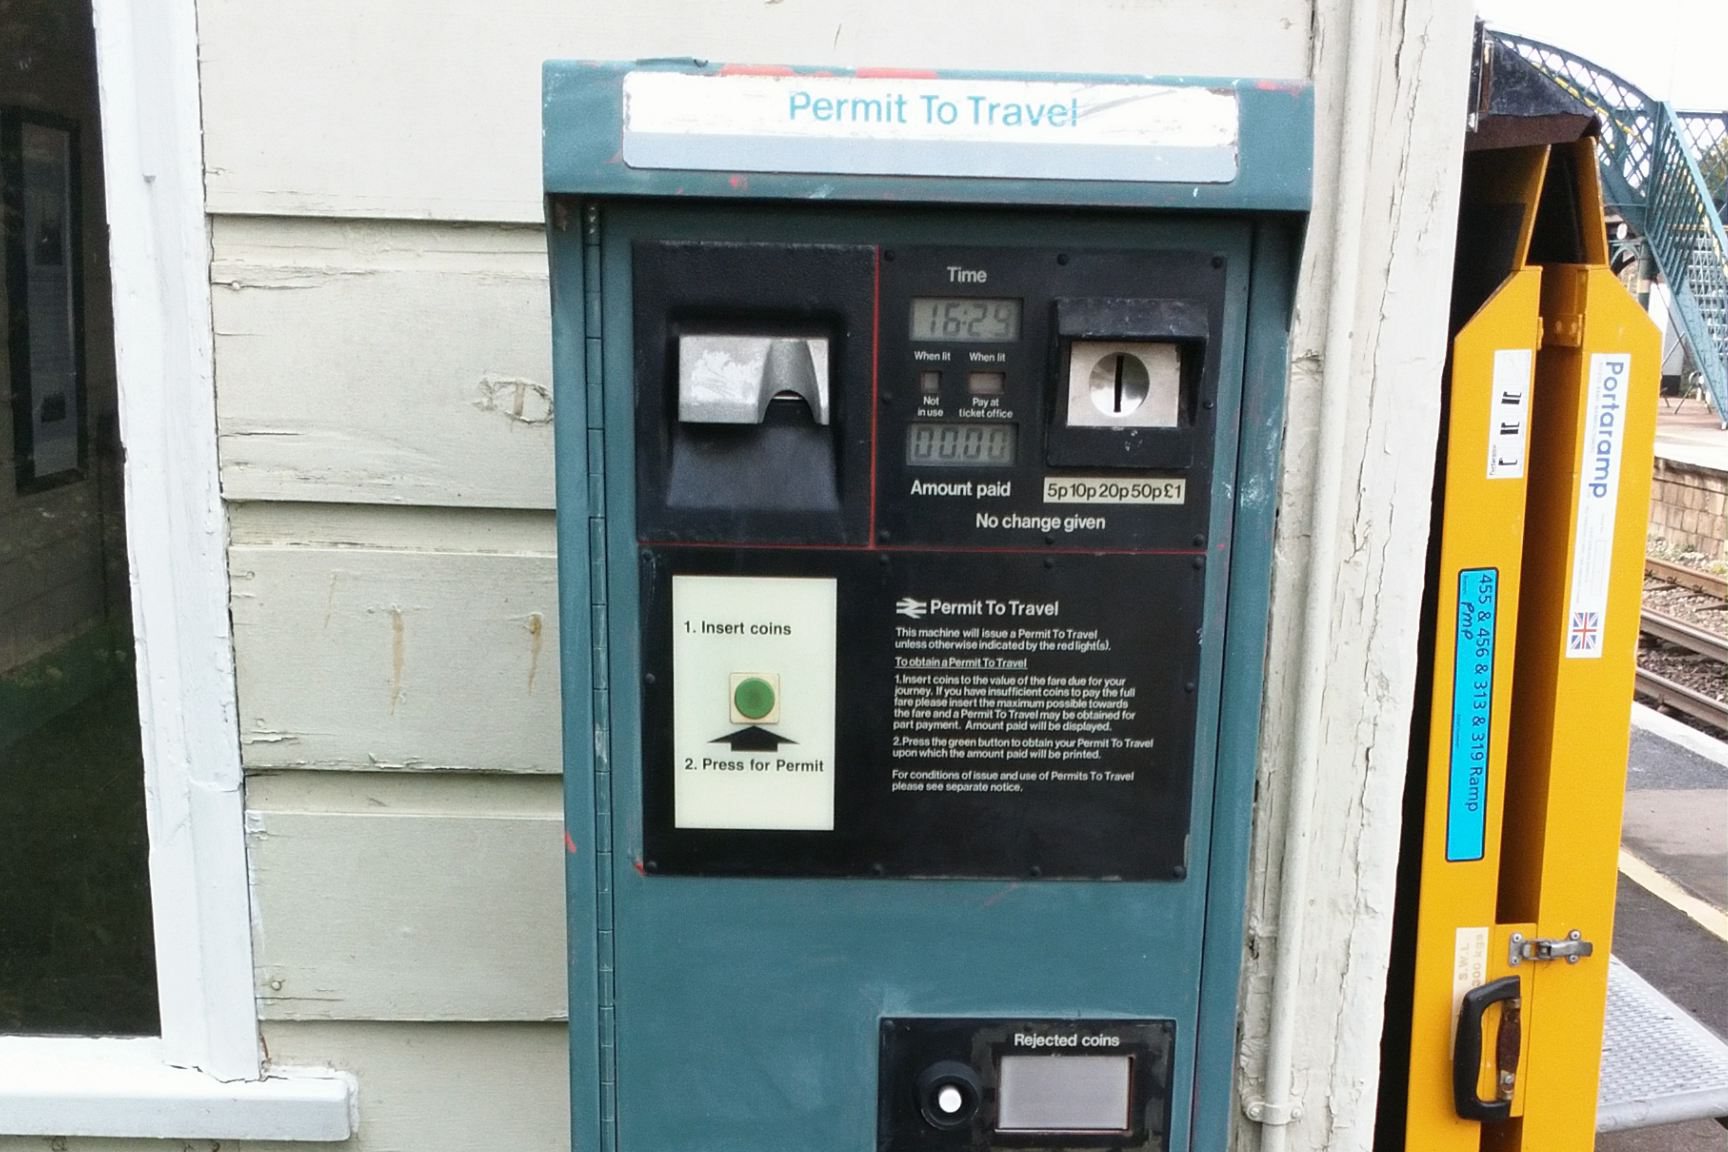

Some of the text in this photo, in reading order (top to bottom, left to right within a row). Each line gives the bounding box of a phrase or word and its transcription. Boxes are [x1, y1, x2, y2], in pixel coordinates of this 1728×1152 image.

[789, 91, 1078, 127] Permit To Travel
[947, 266, 987, 283] Time
[914, 351, 951, 361] When lit
[969, 352, 1006, 362] When lit
[923, 396, 939, 406] Not
[972, 397, 1000, 408] Pay at
[917, 406, 944, 417] in use
[959, 408, 1014, 419] ticket office
[1589, 361, 1624, 498] Portaramp
[911, 480, 1011, 499] Amount paid
[976, 513, 1106, 532] No change given
[930, 600, 1059, 616] Permit To Travel
[684, 621, 792, 635] 1. Insert coins
[896, 627, 1098, 640] This machine will issue a Permit To Travel
[895, 639, 927, 649] unless
[928, 640, 977, 649] otherwise
[979, 640, 1025, 650] indicated
[1026, 640, 1038, 652] by
[1039, 640, 1055, 650] the
[1057, 640, 1075, 650] red
[895, 656, 908, 667] To
[909, 657, 940, 667] obtain
[949, 657, 981, 668] Permit
[982, 657, 995, 668] To
[996, 658, 1027, 668] Travel
[932, 675, 960, 685] coins
[961, 675, 971, 685] to
[972, 675, 988, 685] the
[989, 675, 1016, 685] value
[1017, 675, 1028, 685] of
[1030, 676, 1046, 686] the
[1047, 676, 1066, 686] fare
[1068, 676, 1087, 686] due
[1088, 676, 1103, 686] for
[1104, 678, 1126, 688] your
[894, 685, 1136, 699] journey. If you have insufficient coins to pay the full
[1465, 574, 1493, 812] 455 & 456 & 313 & 319 Ramp
[894, 697, 1129, 709] fare please insert the maximum possible towards
[894, 708, 910, 718] the
[911, 708, 932, 718] fare
[933, 709, 951, 718] and
[961, 709, 993, 719] Permit
[994, 710, 1007, 719] To
[1008, 710, 1039, 719] Travel
[1040, 711, 1060, 721] may
[1062, 710, 1075, 720] be
[1077, 710, 1120, 720] obtained
[1121, 710, 1136, 720] for
[893, 720, 1112, 733] part payment. Amount paid will be displayed.
[932, 737, 947, 747] the
[948, 739, 976, 748] green
[978, 738, 1010, 747] button
[1011, 738, 1020, 747] to
[1022, 738, 1053, 748] obtain
[1055, 740, 1076, 749] your
[1077, 738, 1109, 748] Permit
[1111, 738, 1123, 748] To
[1124, 738, 1154, 748] Travel
[892, 748, 1101, 760] upon which the amount paid will be printed.
[685, 758, 824, 772] 2. Press for Permit
[892, 769, 1135, 781] For conditions of issue and use of Permits To Travel
[892, 782, 924, 792] please
[946, 783, 988, 792] separate
[1014, 1032, 1120, 1049] Rejected coins
